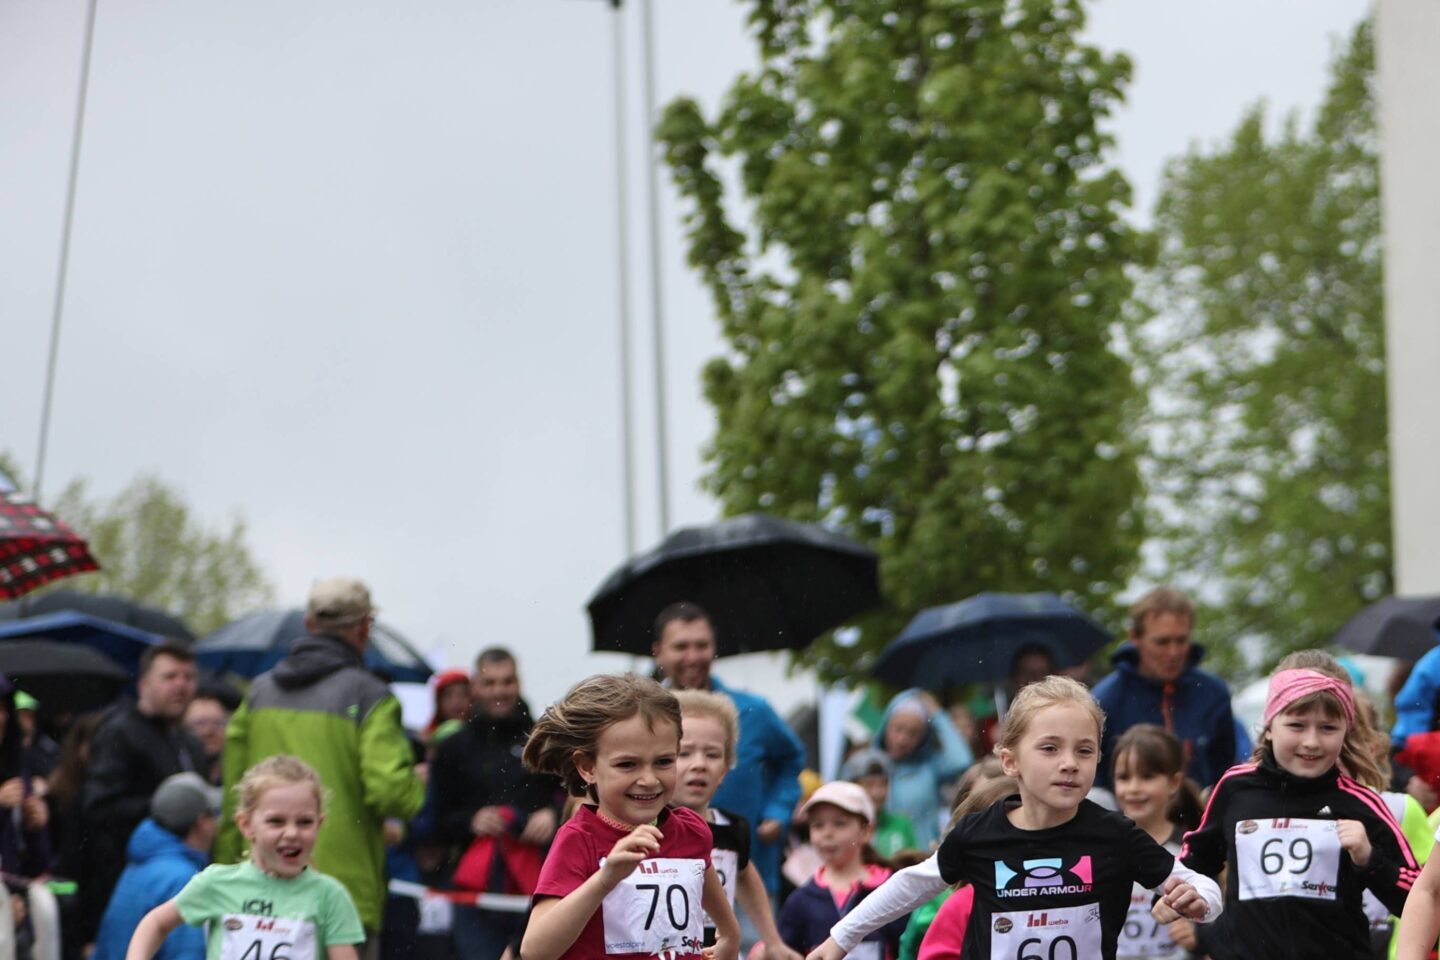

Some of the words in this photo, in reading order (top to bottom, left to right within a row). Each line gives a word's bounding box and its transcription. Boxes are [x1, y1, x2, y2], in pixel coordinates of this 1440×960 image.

[1261, 837, 1313, 875] 69
[996, 887, 1038, 898] UNDER
[1039, 885, 1092, 896] ARMOUR
[242, 899, 274, 916] ICH
[635, 884, 690, 931] 70
